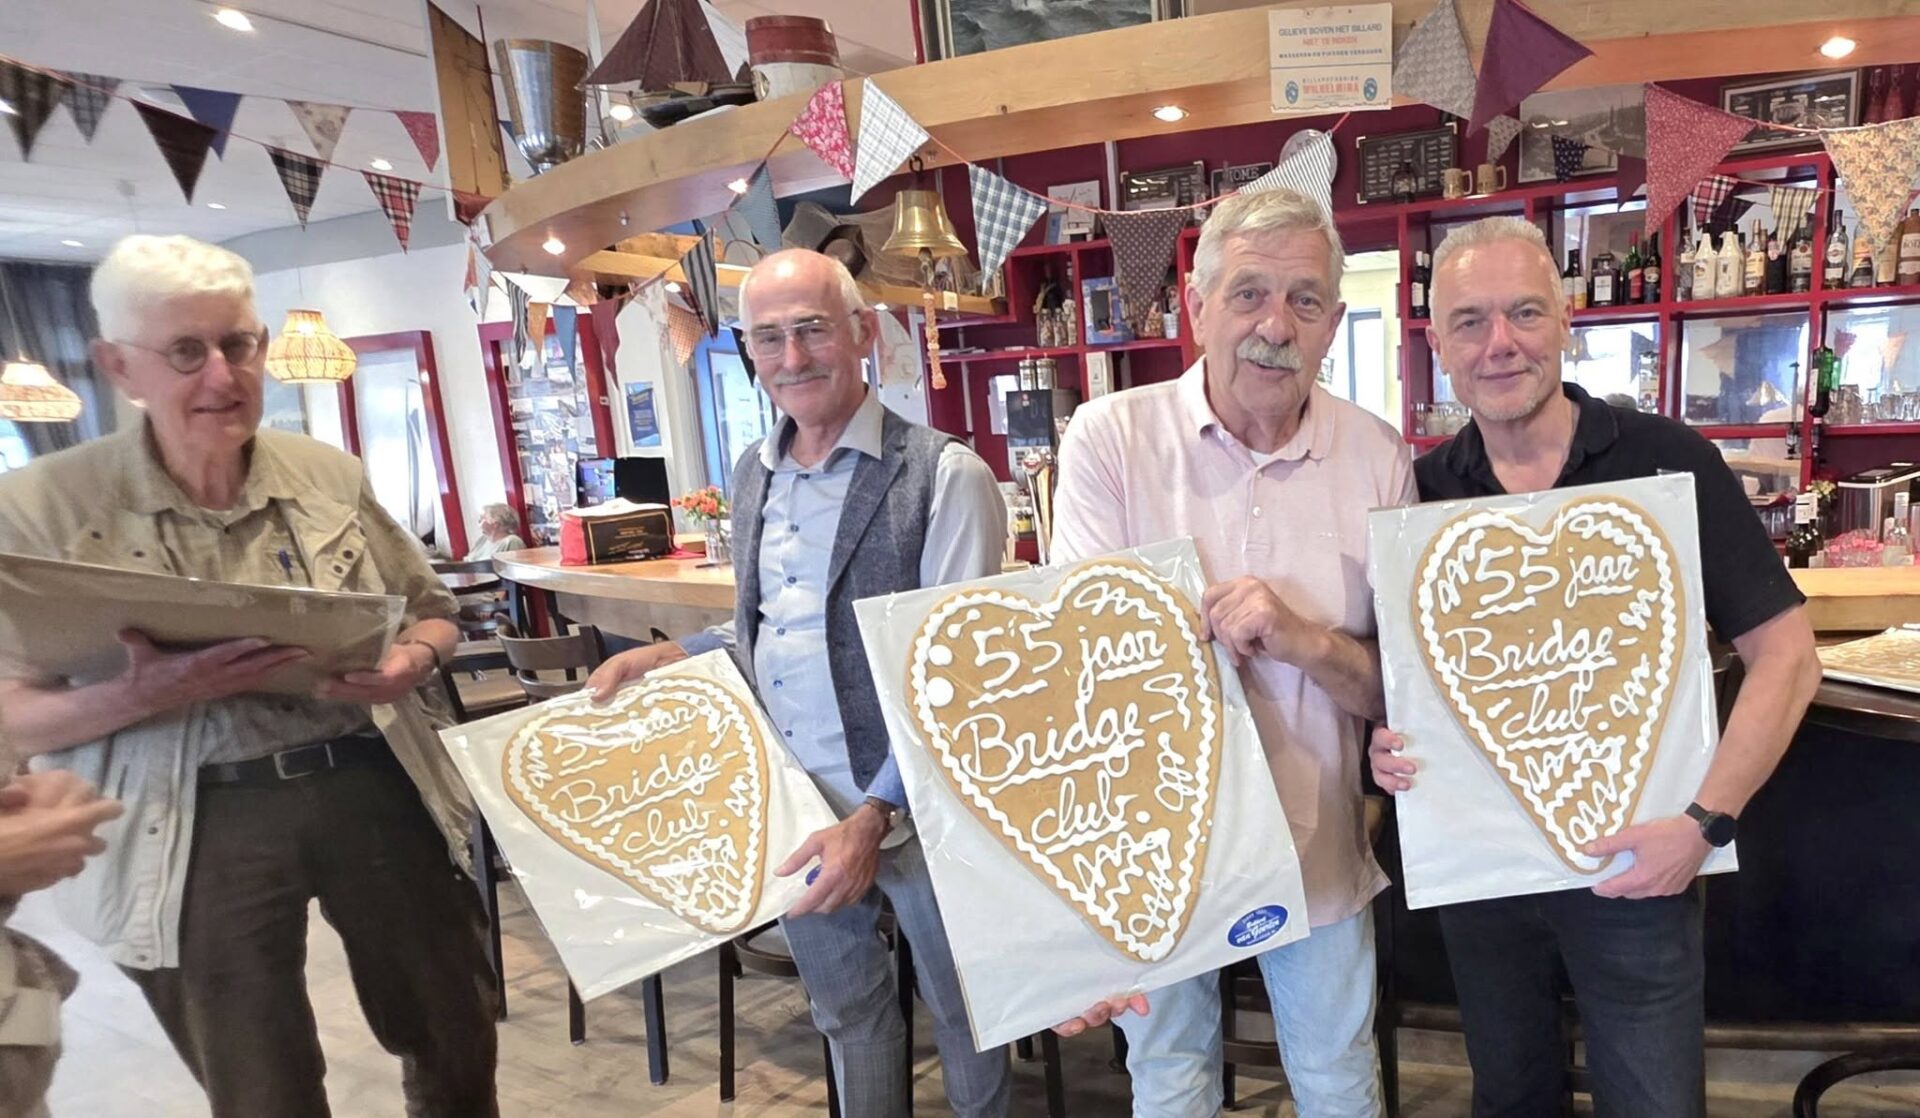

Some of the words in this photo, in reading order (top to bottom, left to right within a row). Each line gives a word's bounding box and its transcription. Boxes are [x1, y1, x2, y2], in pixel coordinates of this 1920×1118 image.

[1309, 26, 1335, 35] BOVEN
[1335, 25, 1350, 34] HET
[1302, 83, 1360, 94] WILHELMINA
[1474, 545, 1560, 606] 55
[1564, 546, 1639, 608] jaar
[972, 620, 1063, 689] 55
[1076, 625, 1168, 701] jaar
